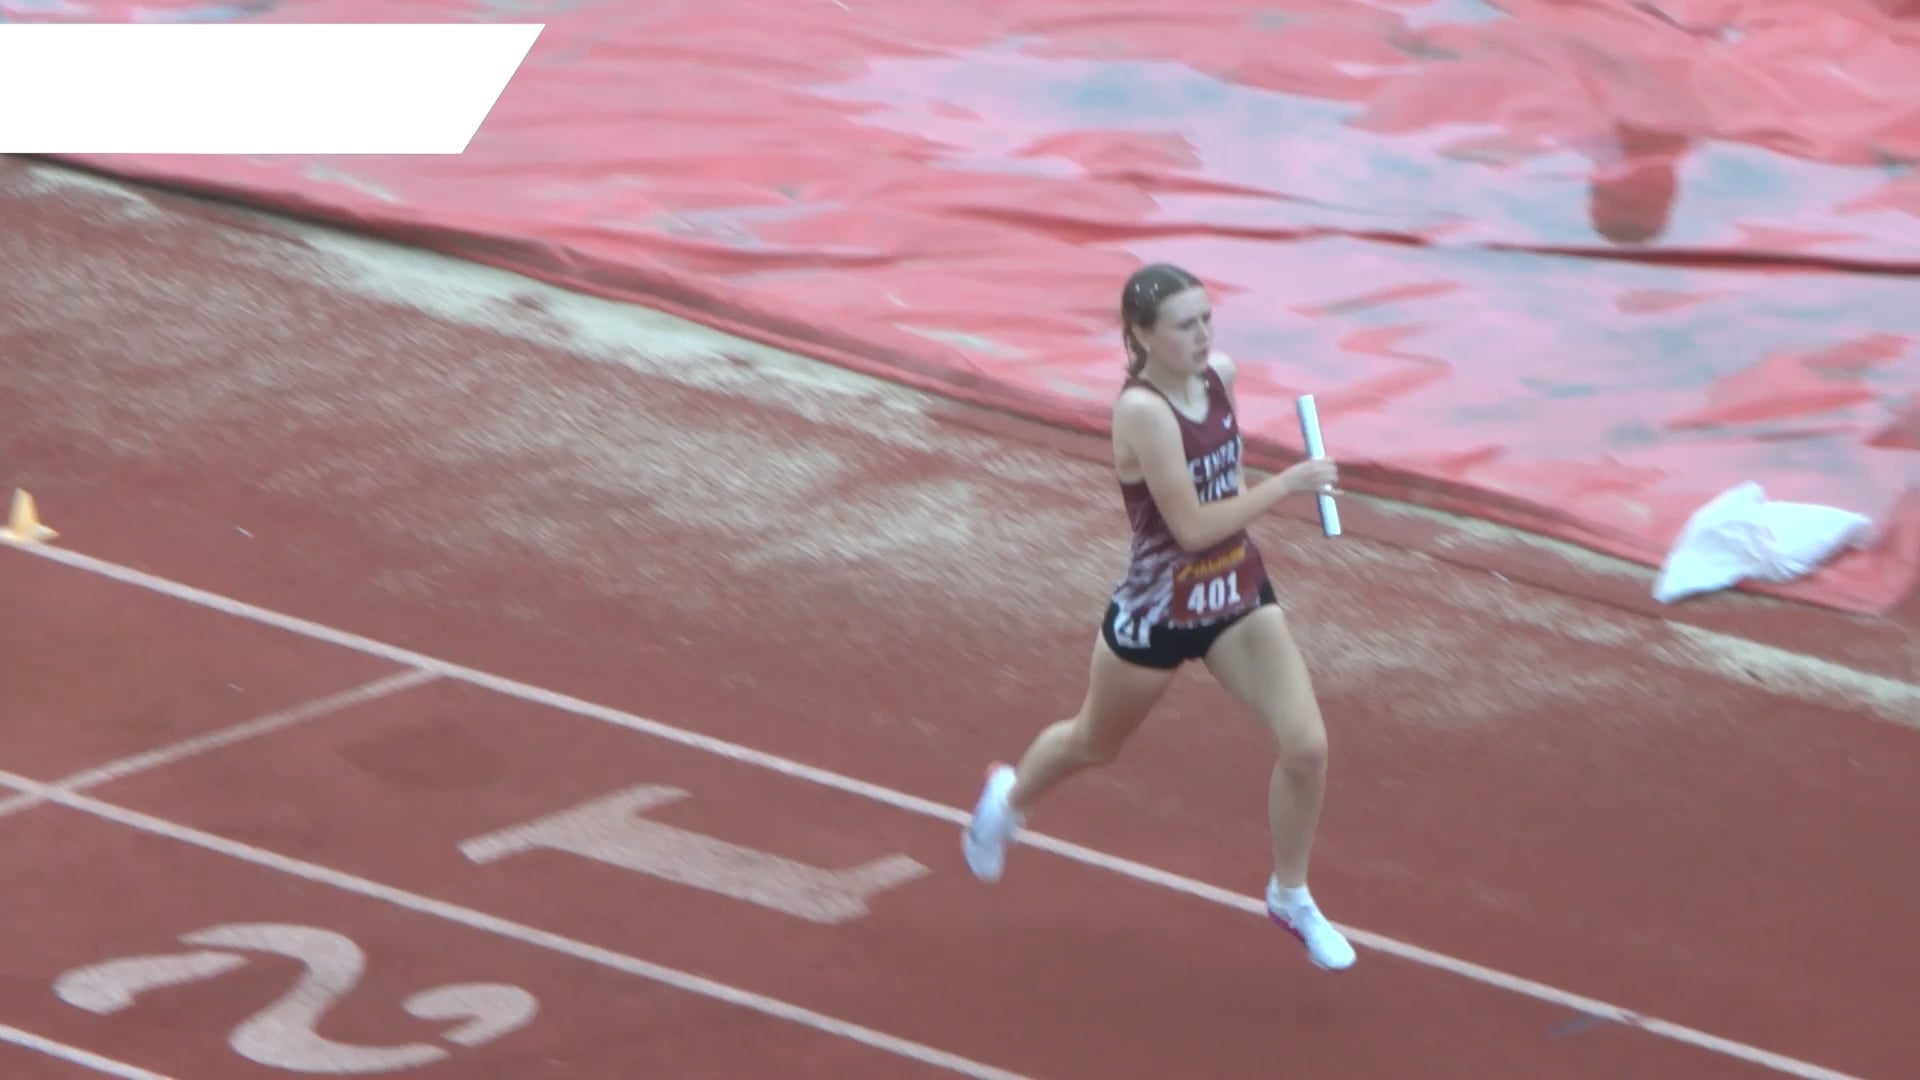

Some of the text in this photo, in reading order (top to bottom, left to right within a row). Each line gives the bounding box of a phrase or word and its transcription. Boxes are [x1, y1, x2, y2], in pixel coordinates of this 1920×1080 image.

[1187, 569, 1241, 616] 401
[457, 784, 932, 924] 1
[52, 921, 540, 1075] 2
